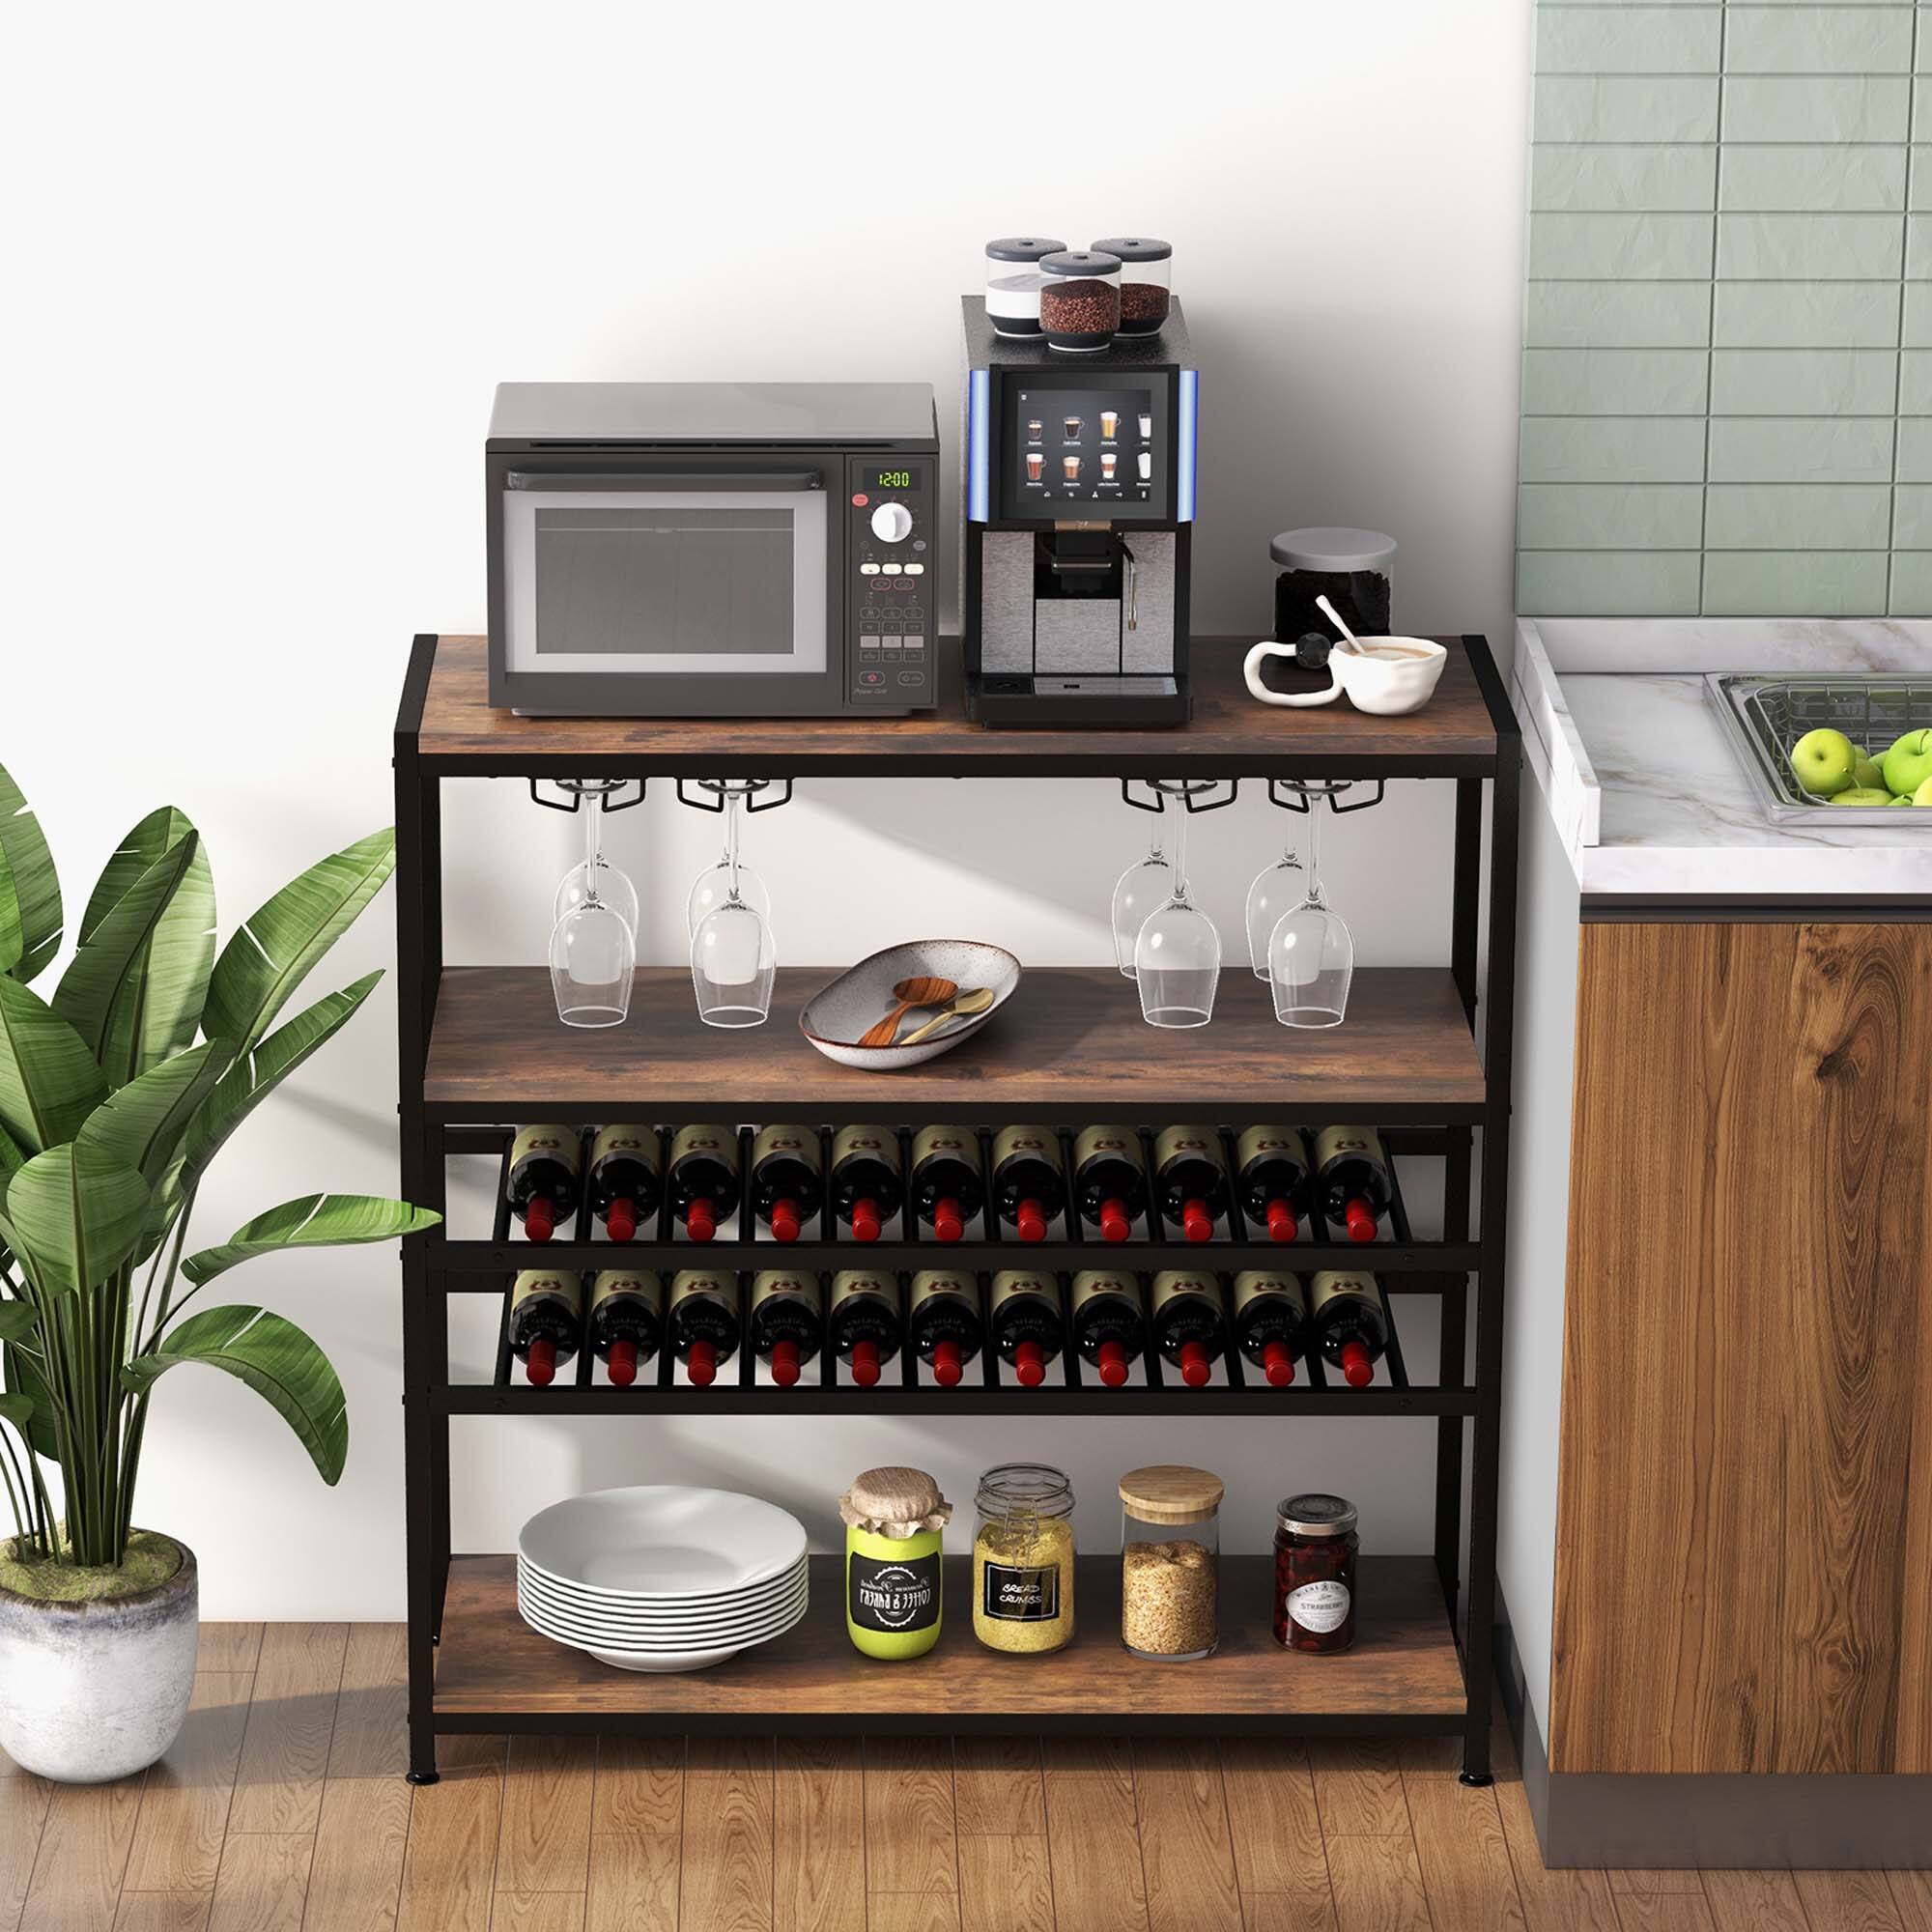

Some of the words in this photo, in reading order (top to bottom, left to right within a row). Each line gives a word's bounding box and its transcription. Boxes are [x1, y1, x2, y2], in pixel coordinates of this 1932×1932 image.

[879, 472, 909, 487] 12:00
[1003, 1584, 1039, 1593] BREAD
[999, 1594, 1042, 1604] CRUMBS
